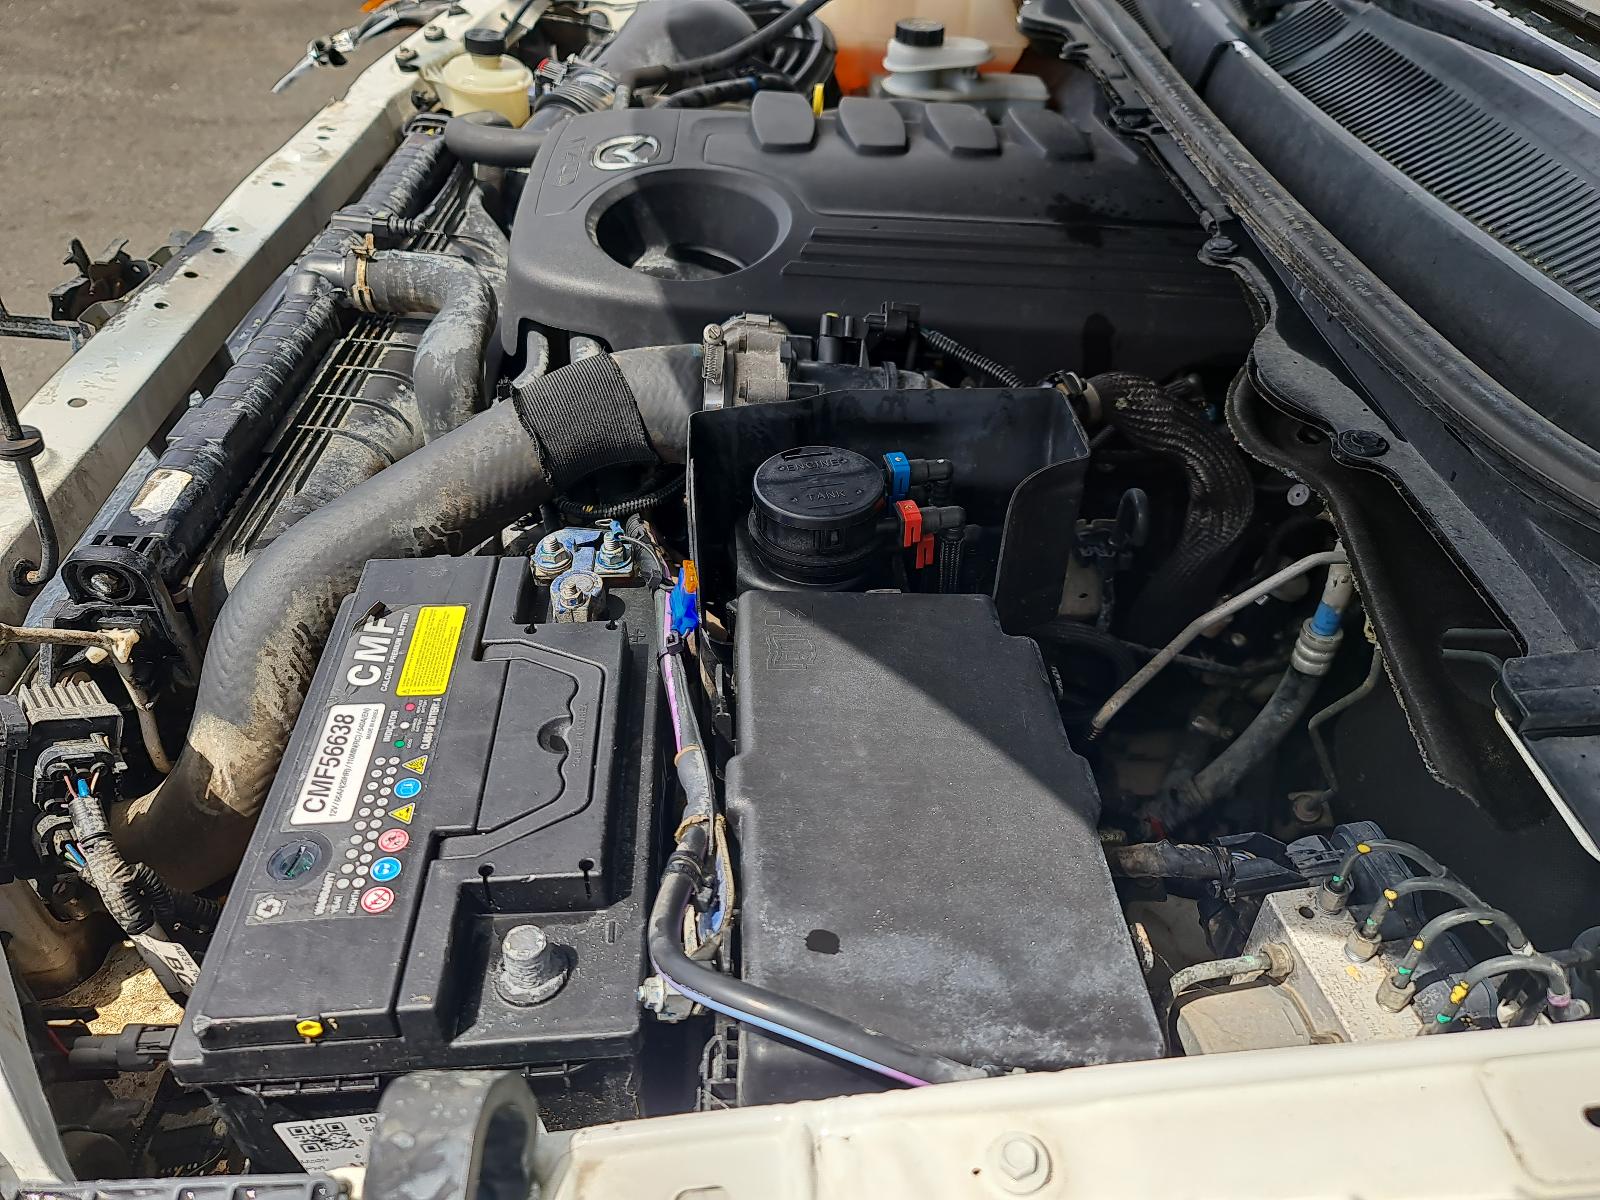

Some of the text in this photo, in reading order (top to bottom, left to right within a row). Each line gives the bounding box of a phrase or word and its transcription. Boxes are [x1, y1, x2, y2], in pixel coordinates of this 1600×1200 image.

[788, 458, 840, 473] ENGINE
[806, 489, 847, 501] TANK
[347, 615, 396, 687] CMF
[380, 612, 411, 692] CALCIUM PREMIUM BATTERY
[383, 710, 399, 741] INDICATOR
[420, 733, 433, 749] CLASS
[303, 713, 355, 814] CMF56638
